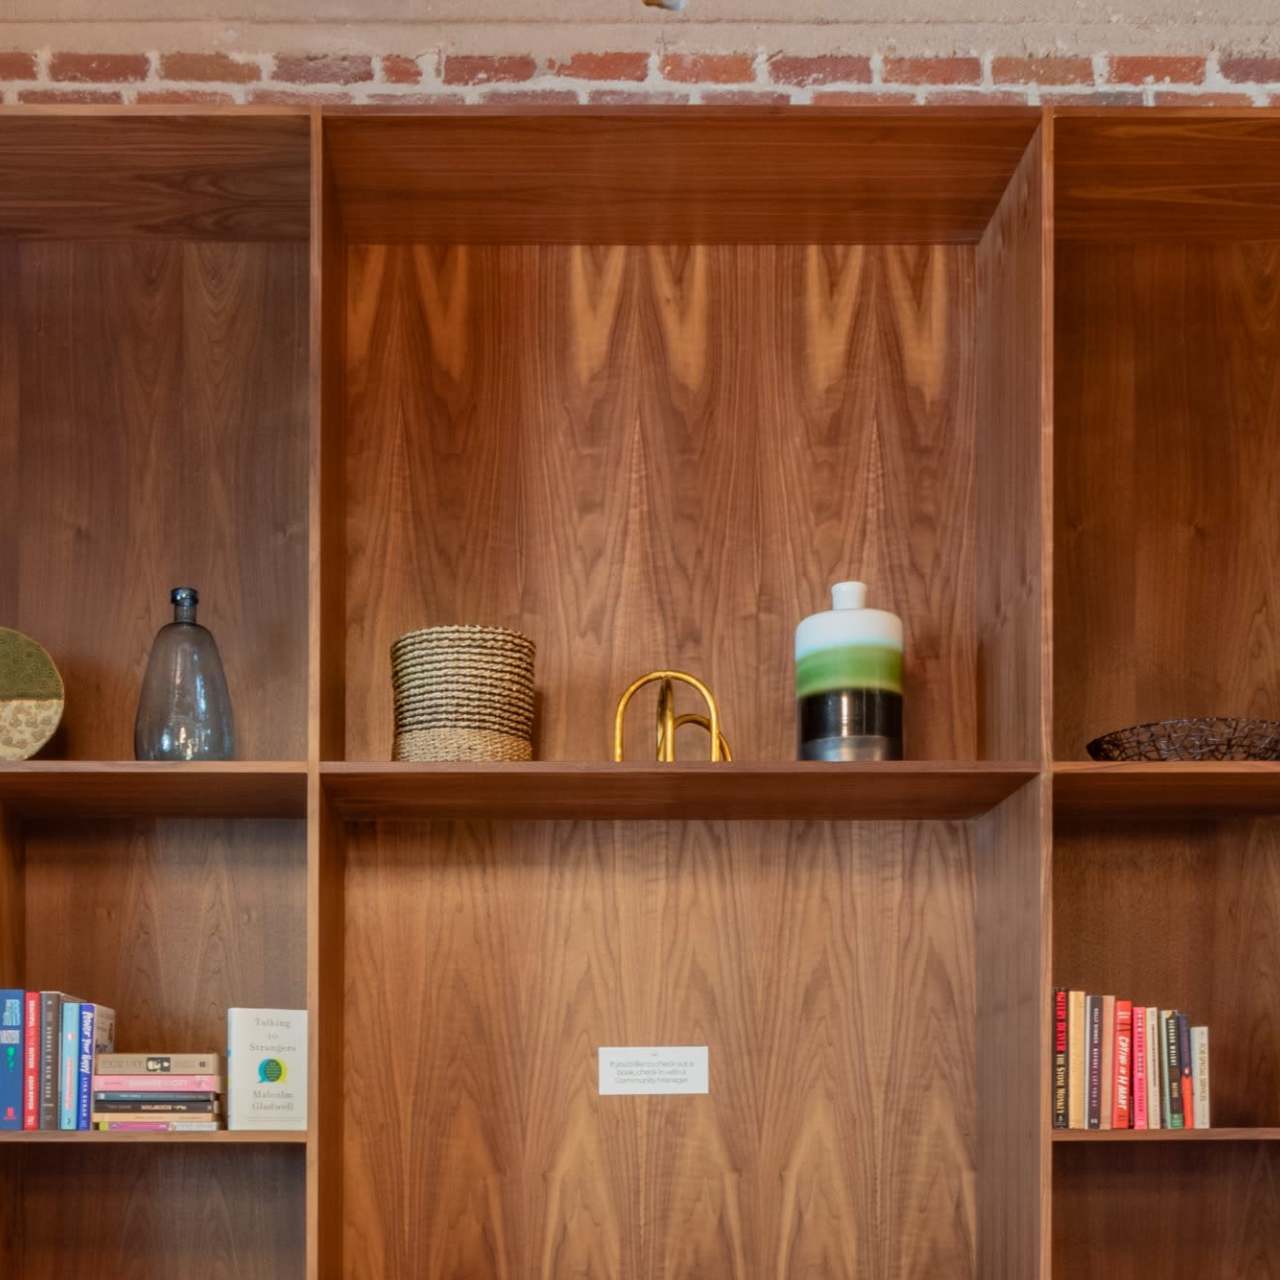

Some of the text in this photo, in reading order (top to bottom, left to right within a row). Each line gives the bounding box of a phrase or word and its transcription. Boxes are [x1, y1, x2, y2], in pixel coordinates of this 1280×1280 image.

[1118, 1036, 1130, 1065] CRYING
[1118, 1076, 1129, 1084] H
[1118, 1086, 1128, 1110] MART
